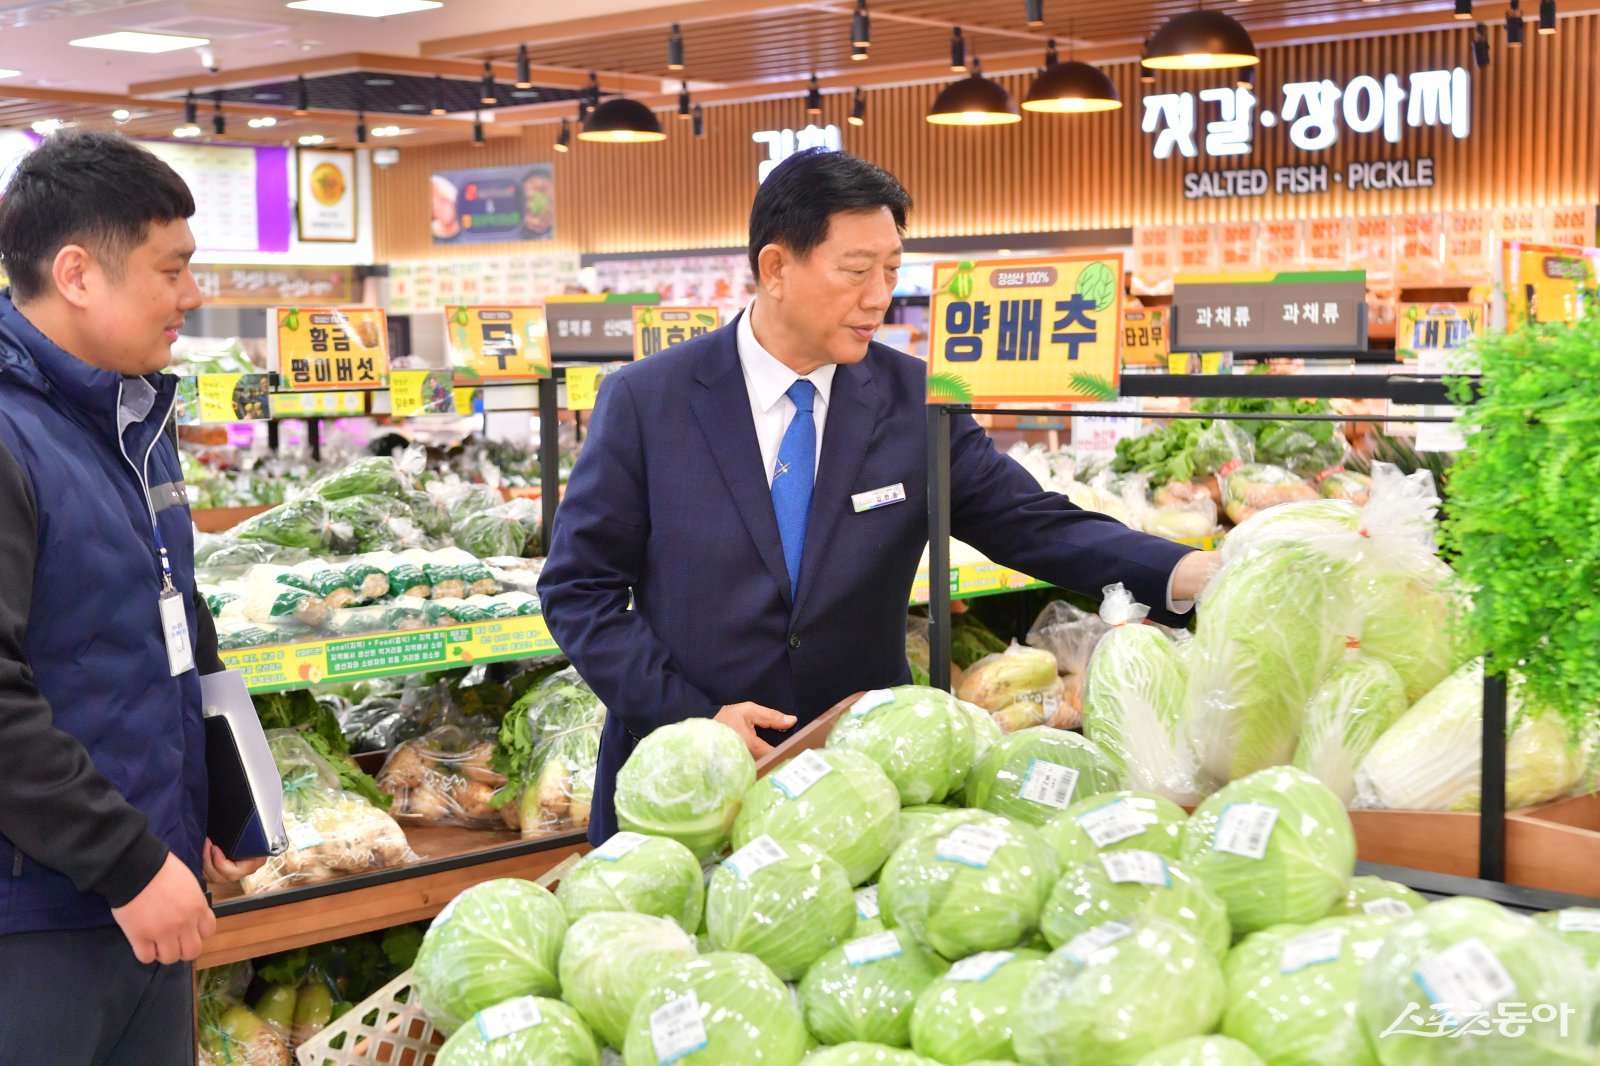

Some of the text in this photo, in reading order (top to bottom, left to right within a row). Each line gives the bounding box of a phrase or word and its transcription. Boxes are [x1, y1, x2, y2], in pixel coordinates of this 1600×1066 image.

[1184, 168, 1268, 198] SALTED
[1275, 165, 1329, 194] FISH
[1348, 158, 1434, 191] PICKLE
[998, 270, 1050, 286] 장성산 100%
[1195, 305, 1252, 328] 과채류
[1282, 301, 1340, 325] 과채류
[310, 327, 351, 352] 황금
[945, 294, 1097, 362] 양배추
[1121, 327, 1162, 347] 타리무
[481, 323, 518, 370] 무
[291, 358, 374, 383] 팽이버섯
